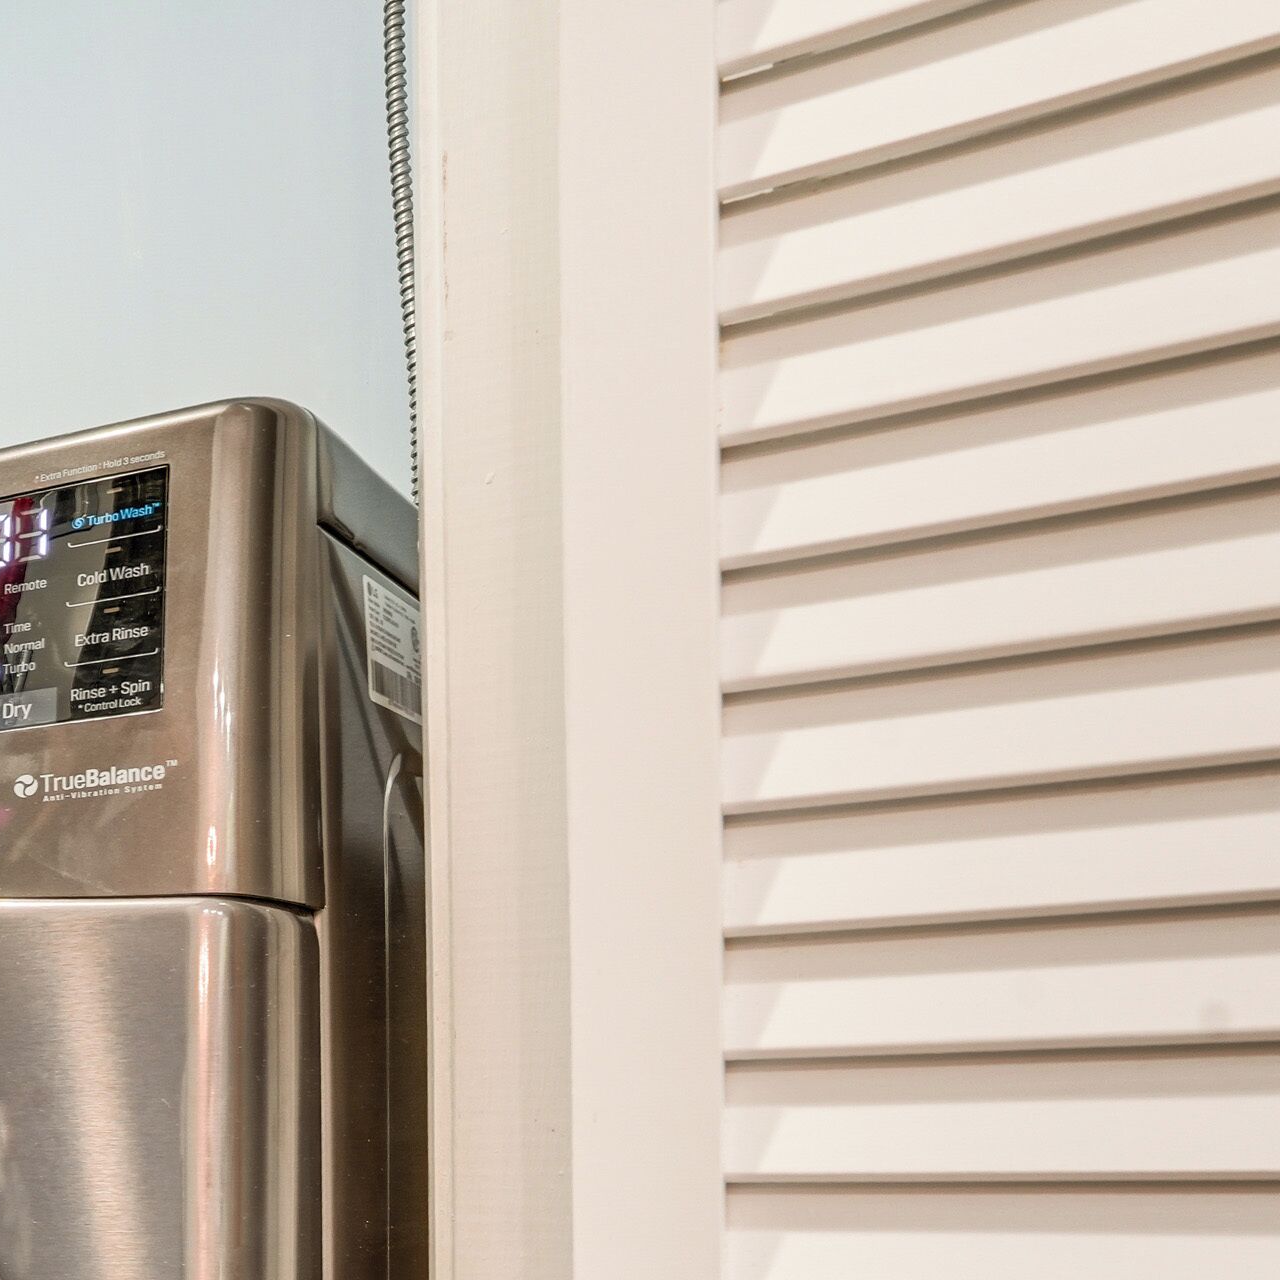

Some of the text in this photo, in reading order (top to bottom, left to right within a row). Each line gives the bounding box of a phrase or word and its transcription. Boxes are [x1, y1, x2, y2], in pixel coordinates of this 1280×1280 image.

[63, 463, 97, 477] Function
[103, 458, 122, 469] Hold
[123, 457, 129, 466] 3
[130, 450, 165, 464] seconds
[77, 563, 150, 587] Cold Wash
[4, 579, 48, 595] Remote
[3, 621, 32, 634] Time
[74, 626, 149, 647] Extra Rinse
[4, 638, 45, 655] Normal
[3, 661, 36, 674] Turbo
[70, 688, 106, 702] Rinse
[121, 679, 151, 696] Spin
[119, 697, 142, 707] Lock
[2, 703, 32, 719] Dry
[42, 782, 163, 803] Anti-Vibration System
